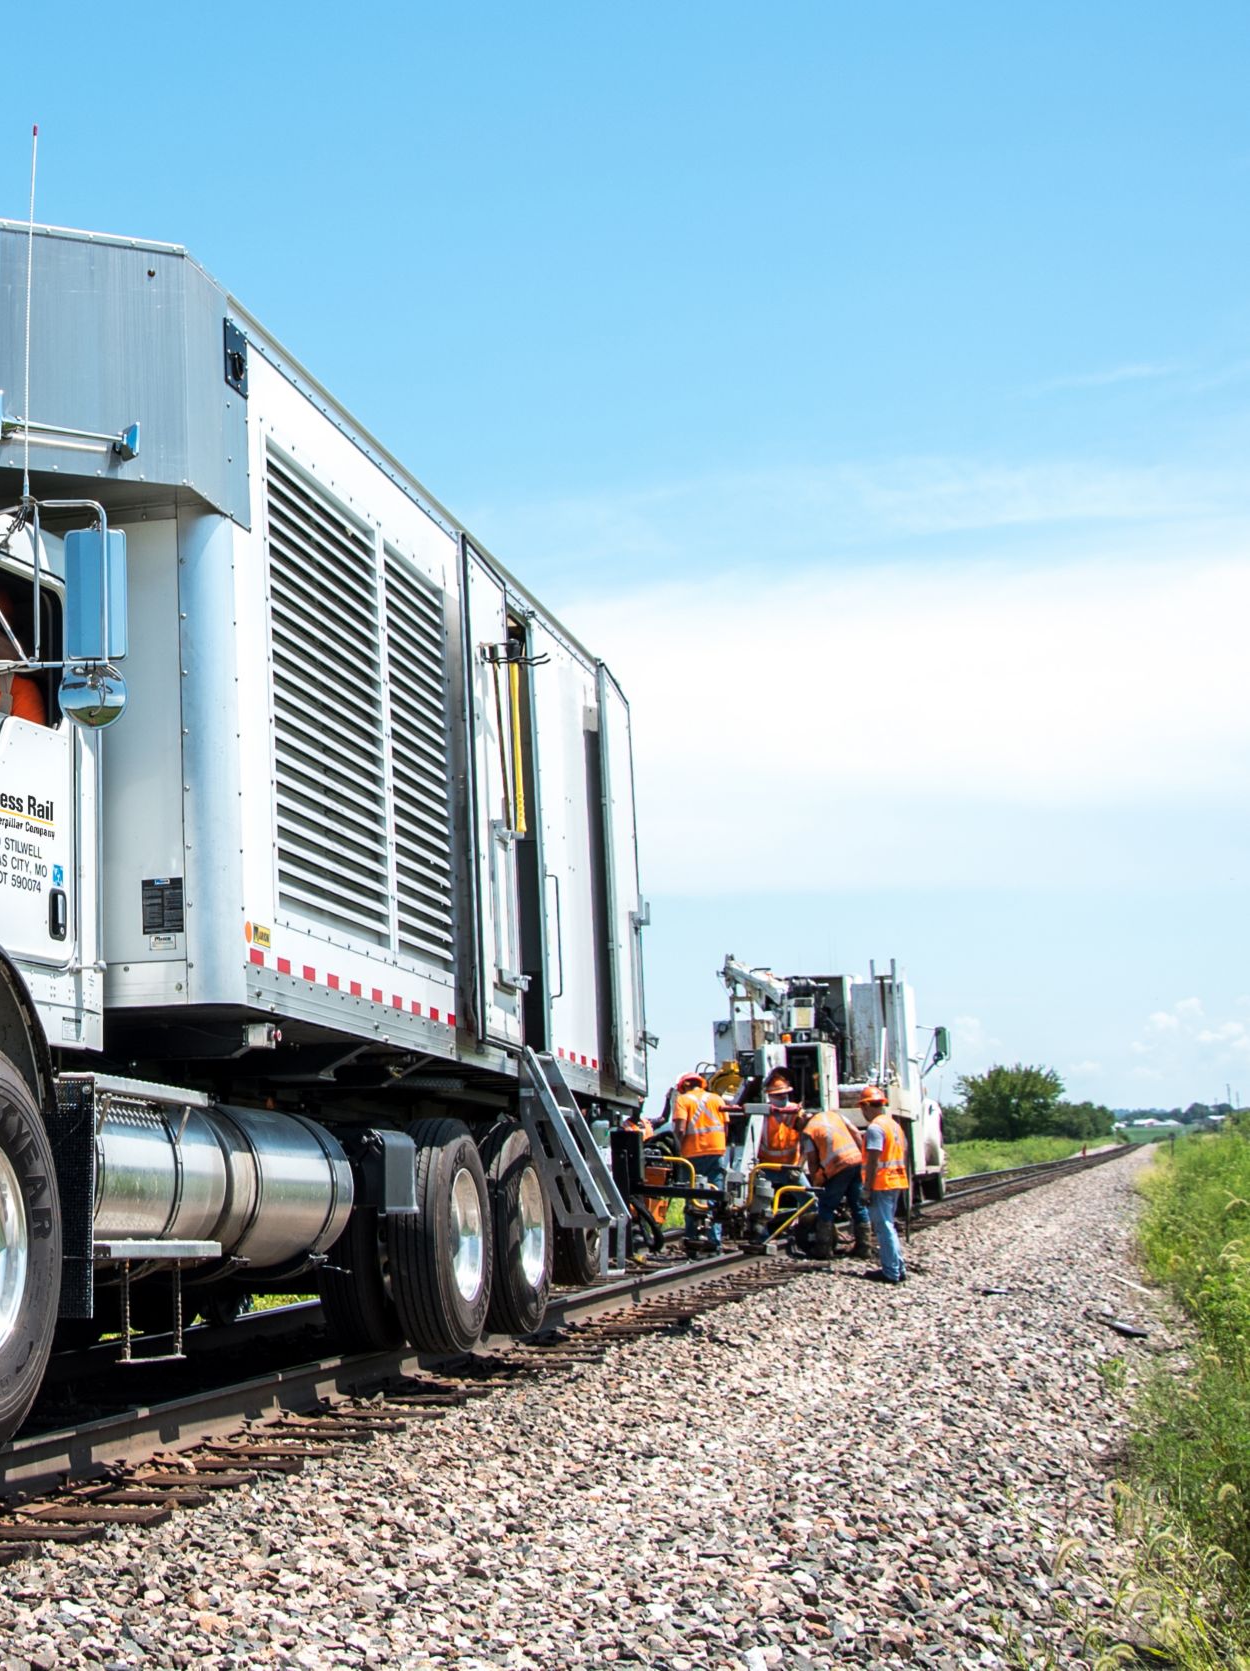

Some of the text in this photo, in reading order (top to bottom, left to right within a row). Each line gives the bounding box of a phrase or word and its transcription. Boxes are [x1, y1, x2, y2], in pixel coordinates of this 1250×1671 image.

[28, 795, 54, 821] Rail
[25, 821, 56, 840] Company
[4, 837, 42, 859] STILWELL
[11, 856, 32, 874] CITY,
[35, 863, 47, 878] MO
[11, 874, 42, 893] 590074
